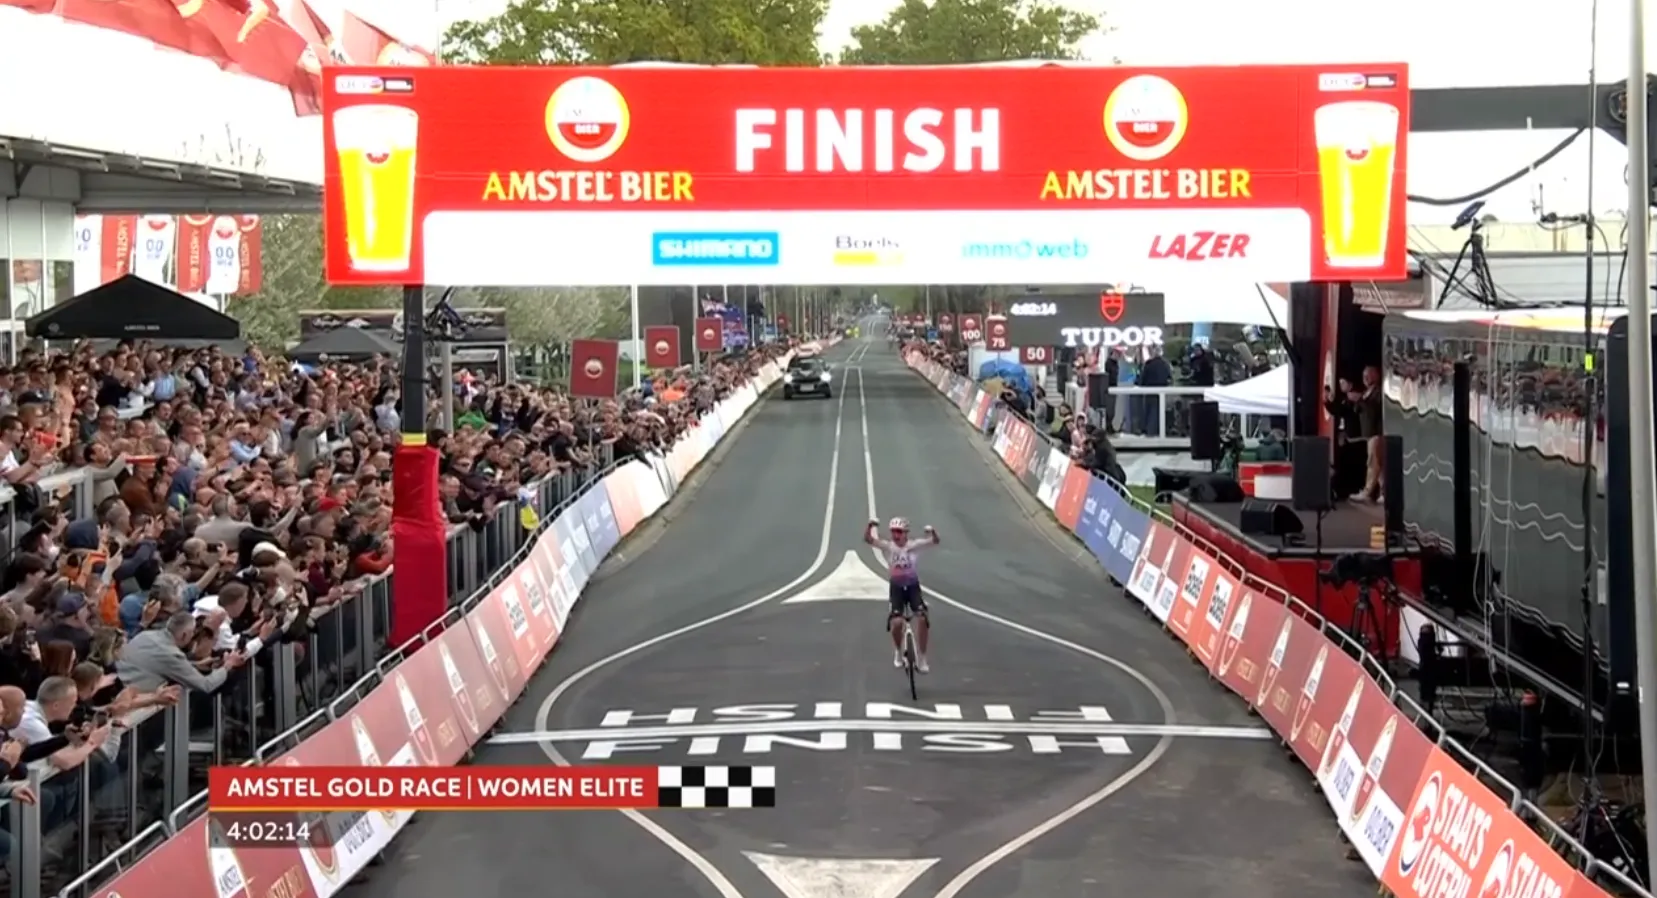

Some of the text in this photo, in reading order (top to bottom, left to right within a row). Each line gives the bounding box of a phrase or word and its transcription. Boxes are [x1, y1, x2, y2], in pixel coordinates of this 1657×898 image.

[735, 107, 1000, 172] FINISH
[482, 172, 694, 202] AMSTEL BIER
[1040, 169, 1251, 200] AMSTEL BIER
[658, 239, 773, 258] SHIMANO
[961, 236, 1089, 259] immoweb
[1148, 231, 1250, 260] LAZER
[962, 329, 981, 340] 100
[991, 337, 1006, 348] 75
[1060, 326, 1164, 346] TUDOR
[1026, 346, 1045, 360] 50
[581, 731, 1133, 759] FINISH
[1433, 783, 1493, 871] STAATS
